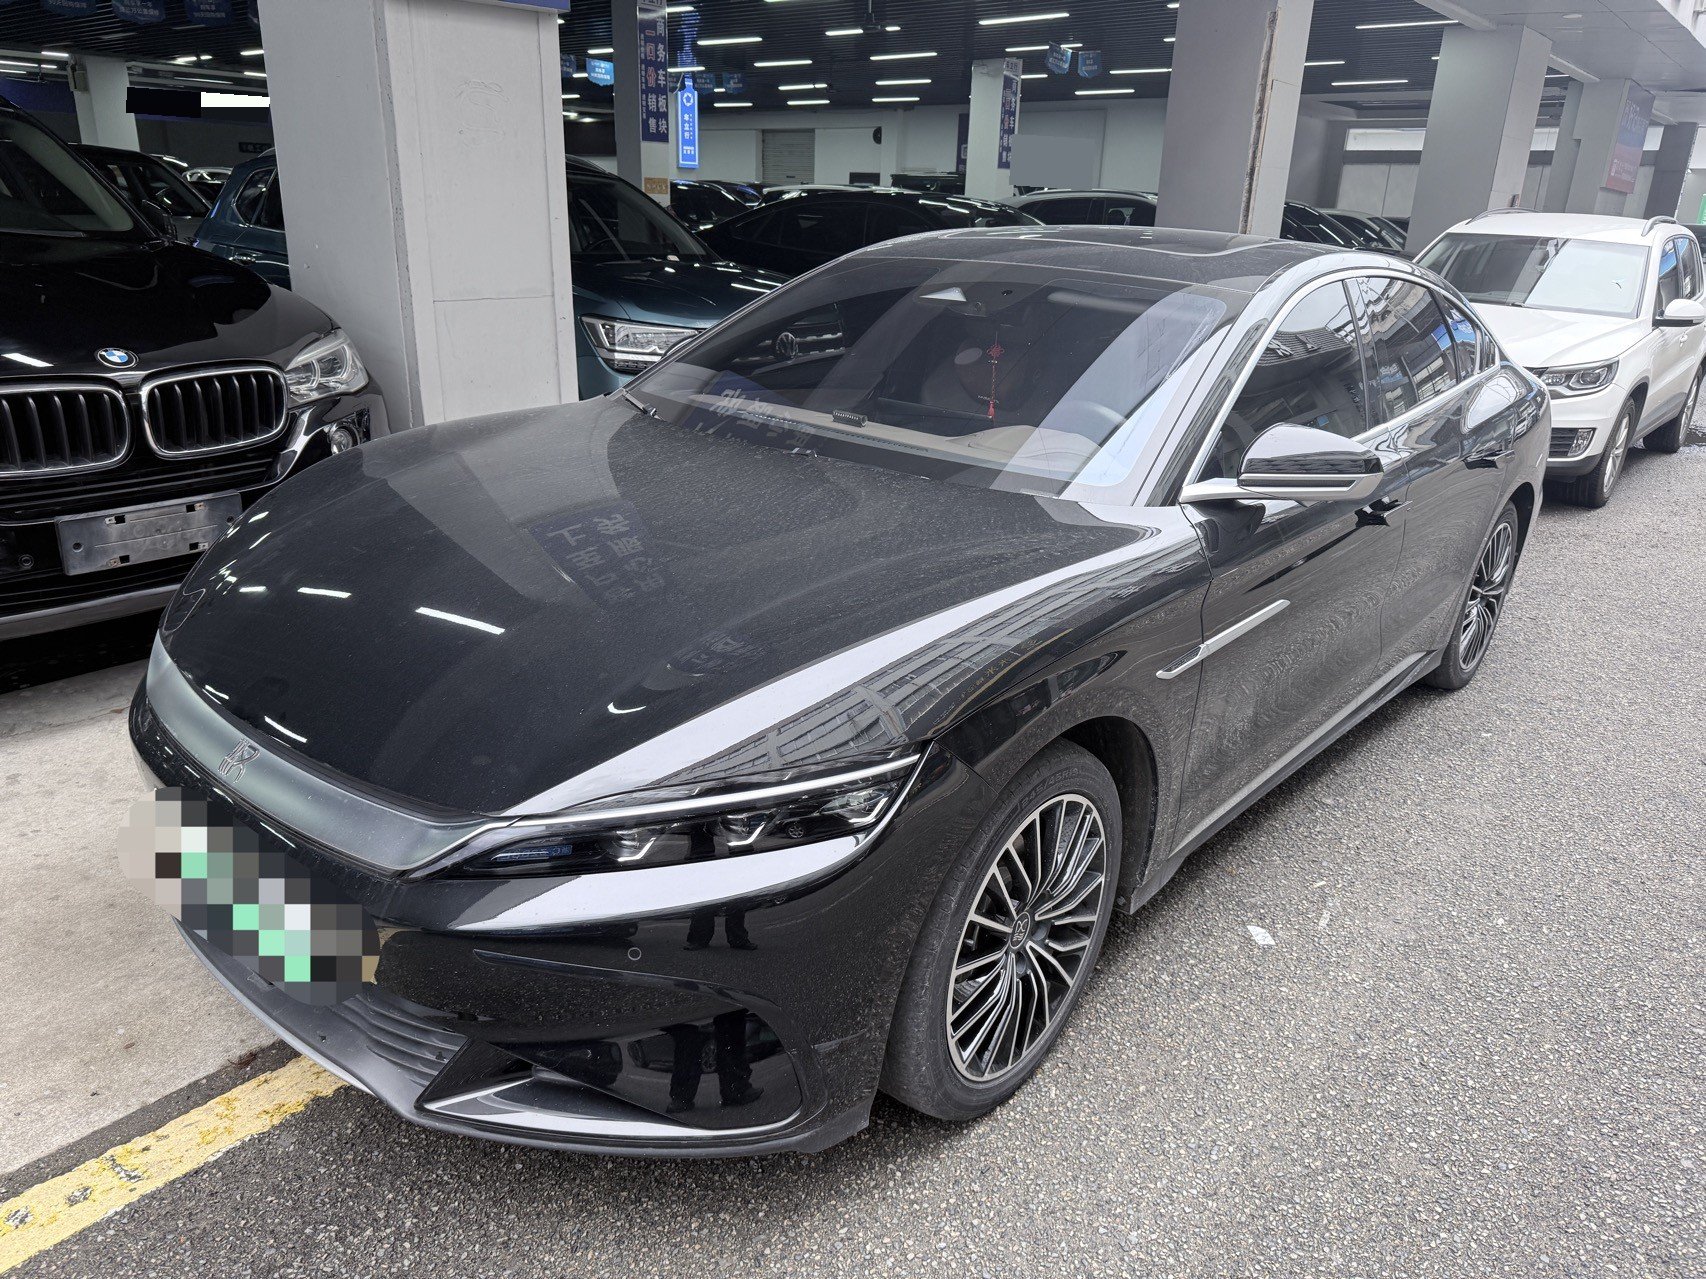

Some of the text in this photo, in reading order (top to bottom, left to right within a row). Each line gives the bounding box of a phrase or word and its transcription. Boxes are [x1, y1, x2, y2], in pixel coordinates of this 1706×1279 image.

[645, 30, 657, 134] 一口价销售
[656, 17, 668, 134] 商务车板块
